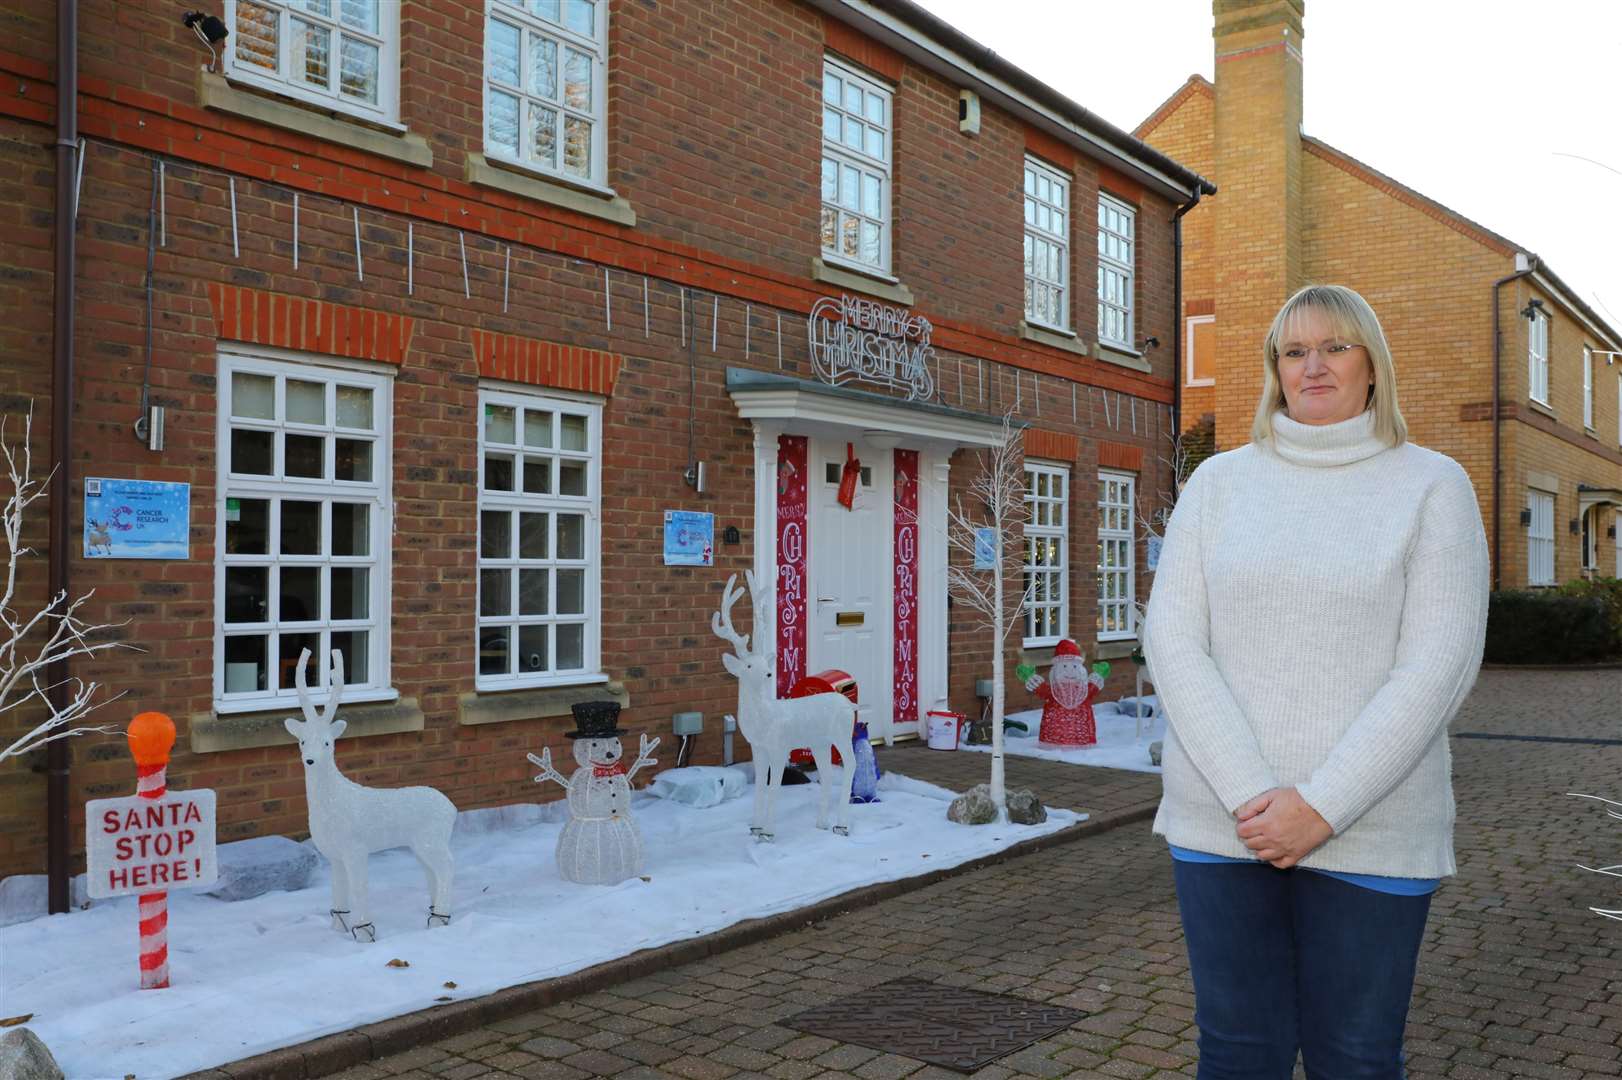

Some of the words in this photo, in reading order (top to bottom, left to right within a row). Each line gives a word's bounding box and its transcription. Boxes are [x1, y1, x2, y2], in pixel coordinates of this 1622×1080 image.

[842, 293, 909, 339] MERRY
[808, 297, 935, 402] CHRISTMAS
[777, 503, 806, 520] MERRY
[779, 522, 803, 694] CHRISTMA
[896, 526, 914, 710] CHRISTMAS
[103, 801, 202, 833] SANTA
[115, 829, 195, 861] STOP
[109, 858, 201, 890] HERE!
